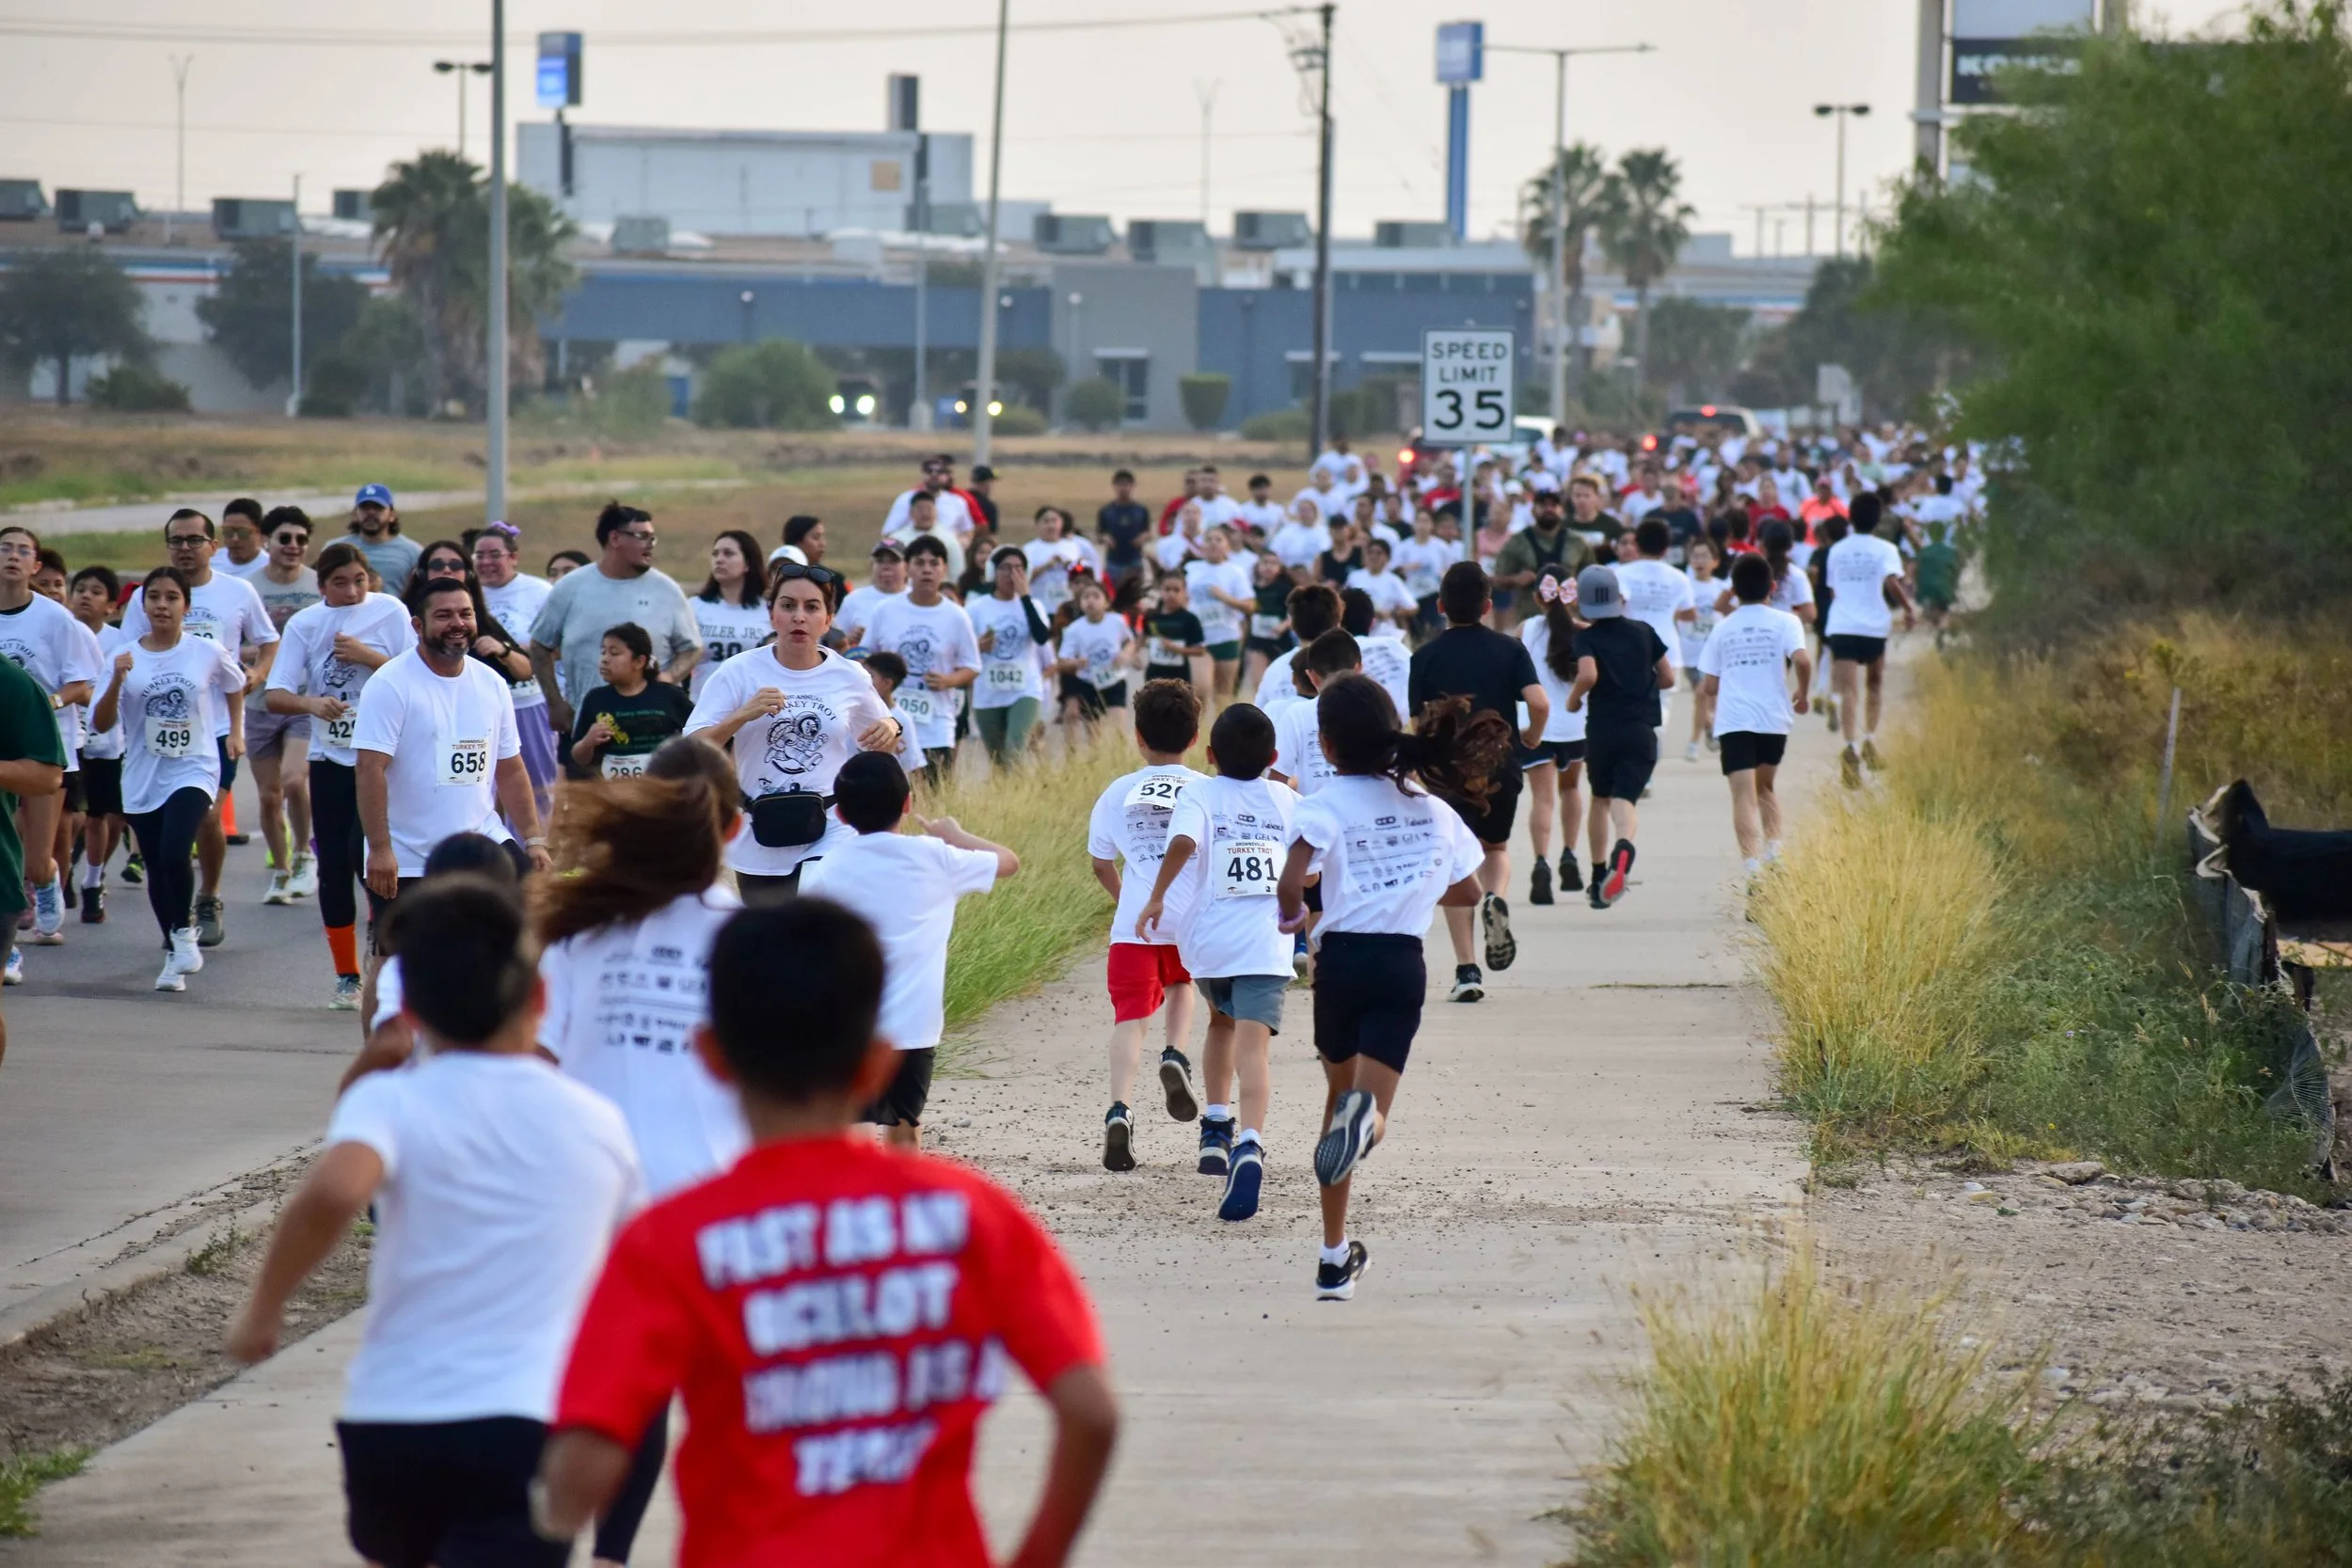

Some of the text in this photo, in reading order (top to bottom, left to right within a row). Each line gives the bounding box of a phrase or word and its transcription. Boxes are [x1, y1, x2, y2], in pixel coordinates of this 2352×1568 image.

[1432, 341, 1507, 359] SPEED
[1438, 366, 1497, 384] LIMIT
[1434, 389, 1505, 431] 35
[990, 670, 1023, 683] 1042
[812, 702, 836, 721] TROT
[893, 697, 930, 715] 050
[156, 730, 190, 749] 499
[452, 751, 486, 773] 658
[1227, 857, 1279, 882] 481
